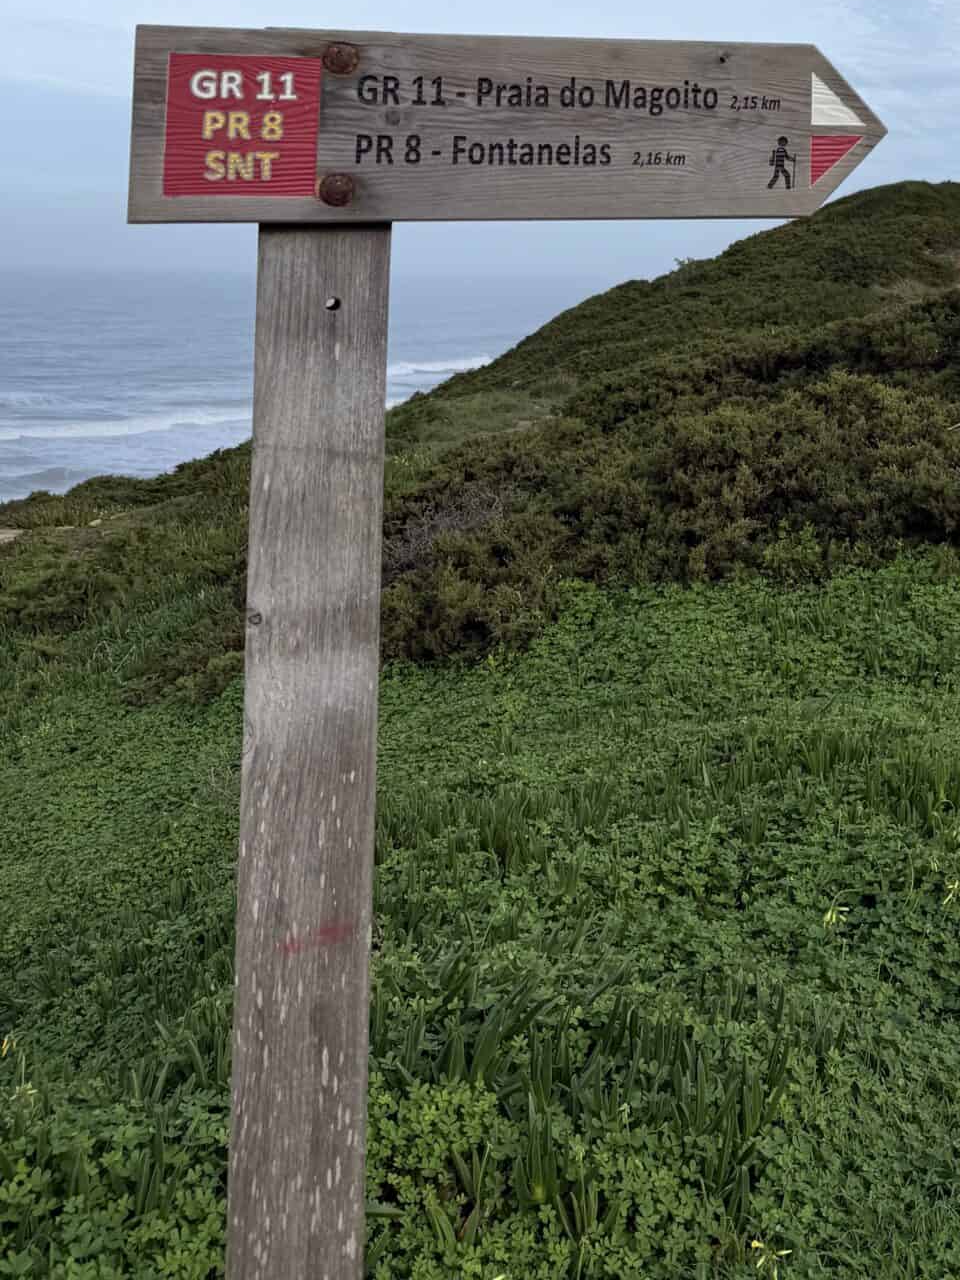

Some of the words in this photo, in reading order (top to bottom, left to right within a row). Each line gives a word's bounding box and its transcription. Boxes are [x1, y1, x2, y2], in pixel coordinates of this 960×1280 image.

[191, 70, 244, 100] GR
[256, 72, 297, 100] 11
[357, 75, 400, 106] GR
[412, 76, 446, 106] 11
[477, 77, 549, 107] Praia
[560, 77, 594, 109] do
[605, 79, 718, 116] Magoito
[730, 95, 758, 111] 2,15
[761, 96, 781, 111] km
[202, 111, 251, 140] PR
[261, 111, 284, 141] 8
[203, 150, 280, 181] SNT
[355, 134, 394, 164] PR
[404, 134, 422, 164] 8
[452, 135, 611, 166] Fontanelas
[632, 151, 662, 168] 2,16
[665, 151, 686, 166] km
